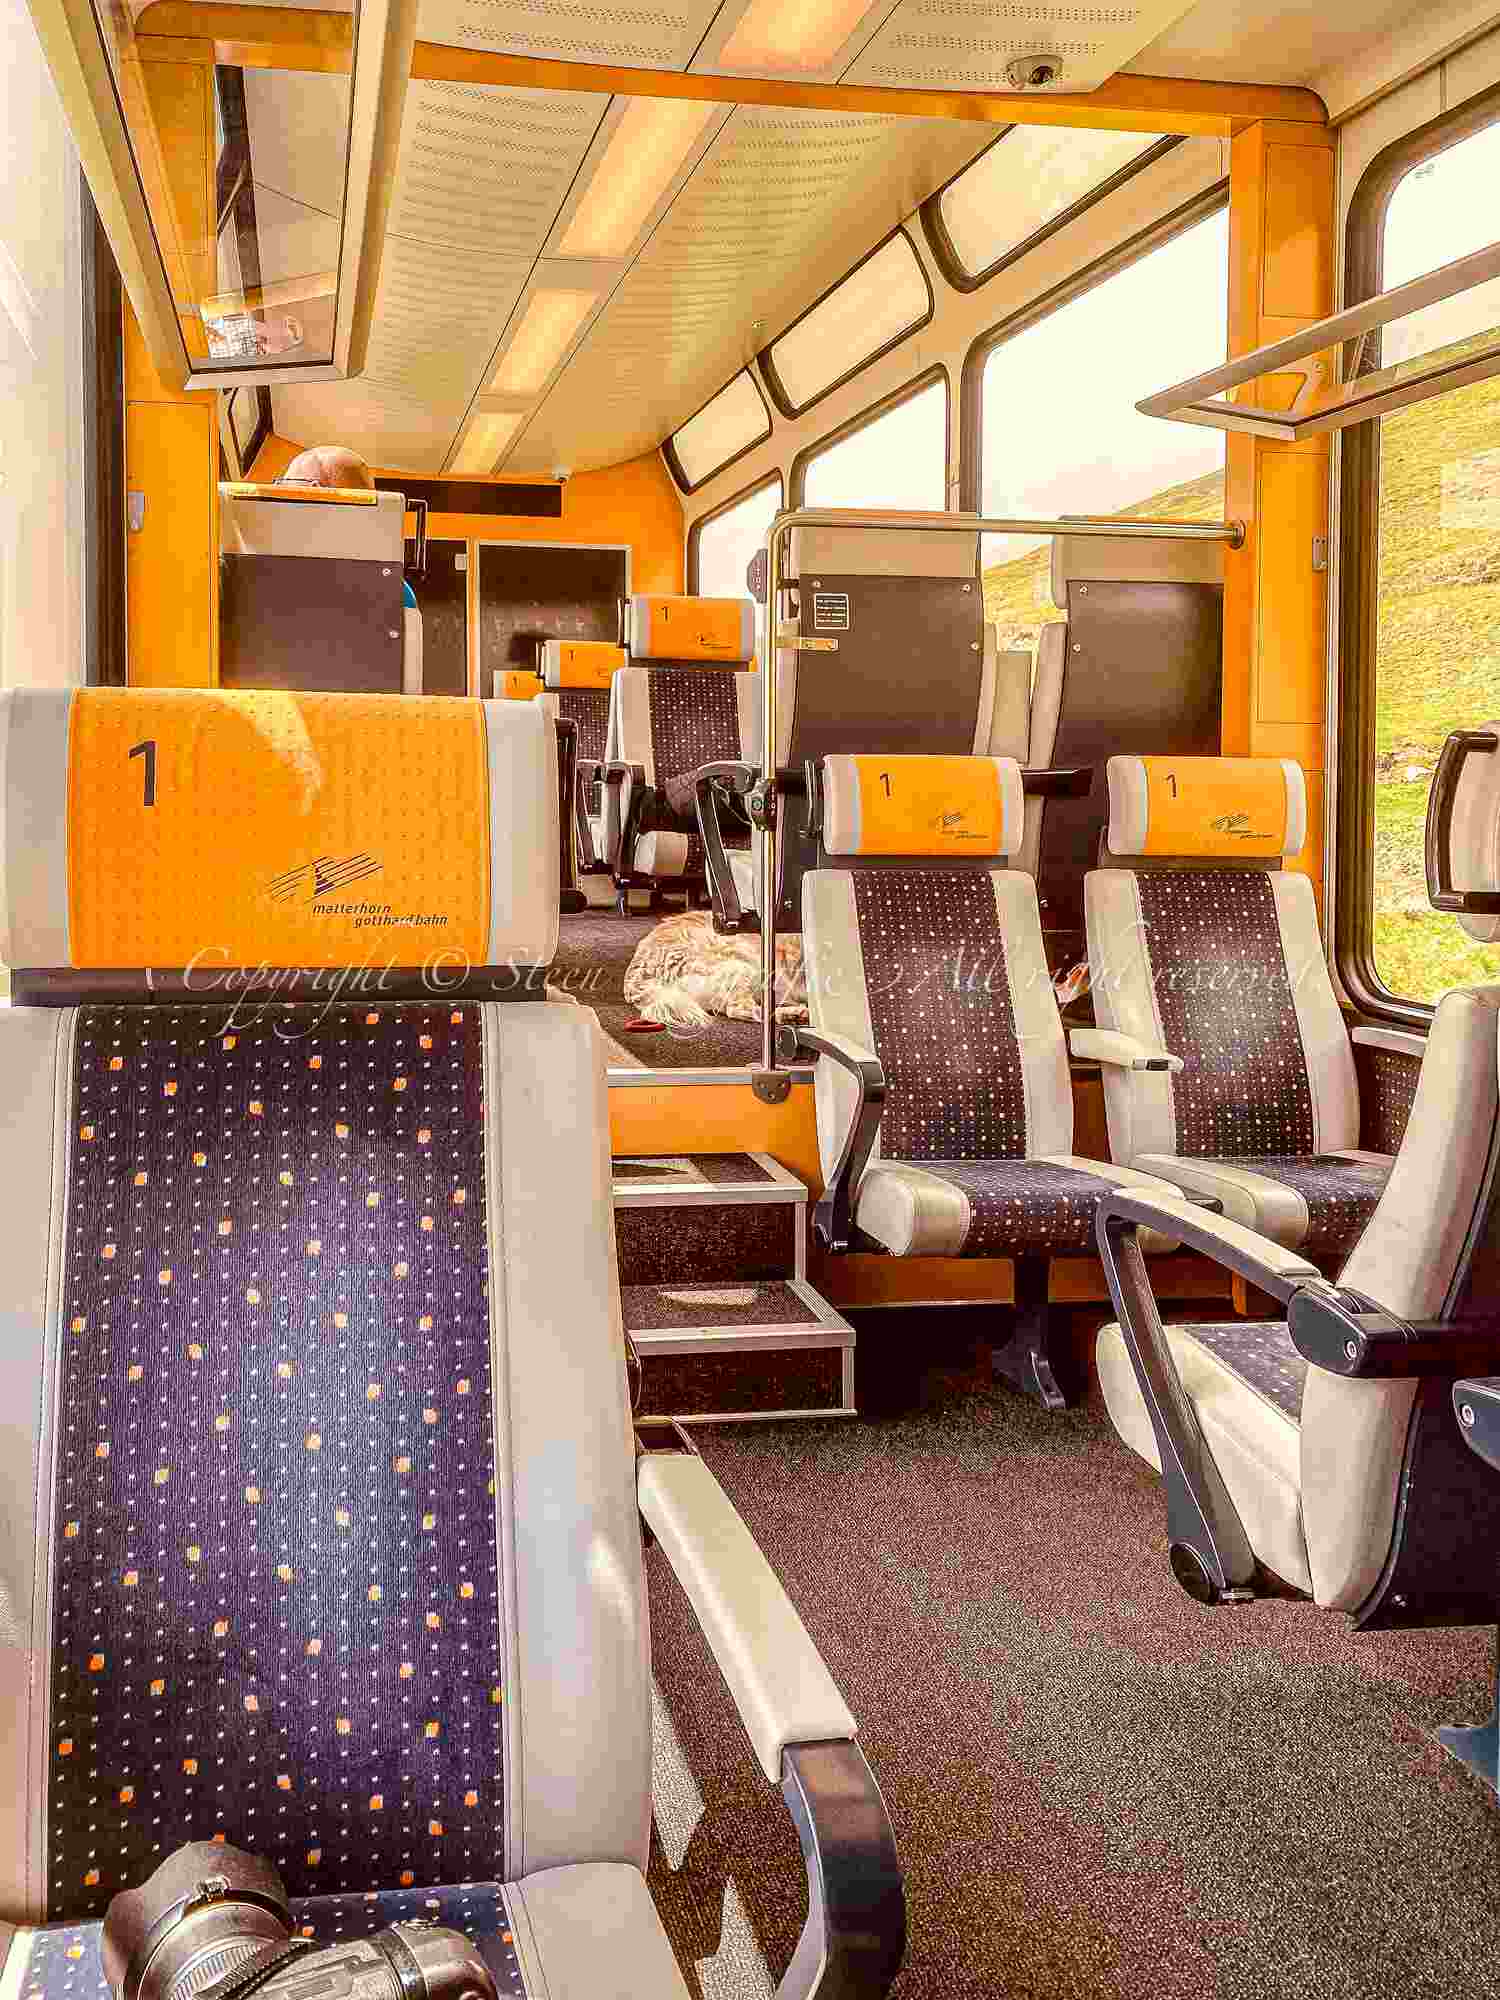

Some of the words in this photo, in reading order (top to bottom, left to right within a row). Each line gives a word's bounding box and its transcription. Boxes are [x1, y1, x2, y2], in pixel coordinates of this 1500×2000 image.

[128, 740, 157, 807] 1
[879, 772, 891, 797] 1
[1165, 774, 1177, 798] 1
[312, 903, 392, 914] matterhorn
